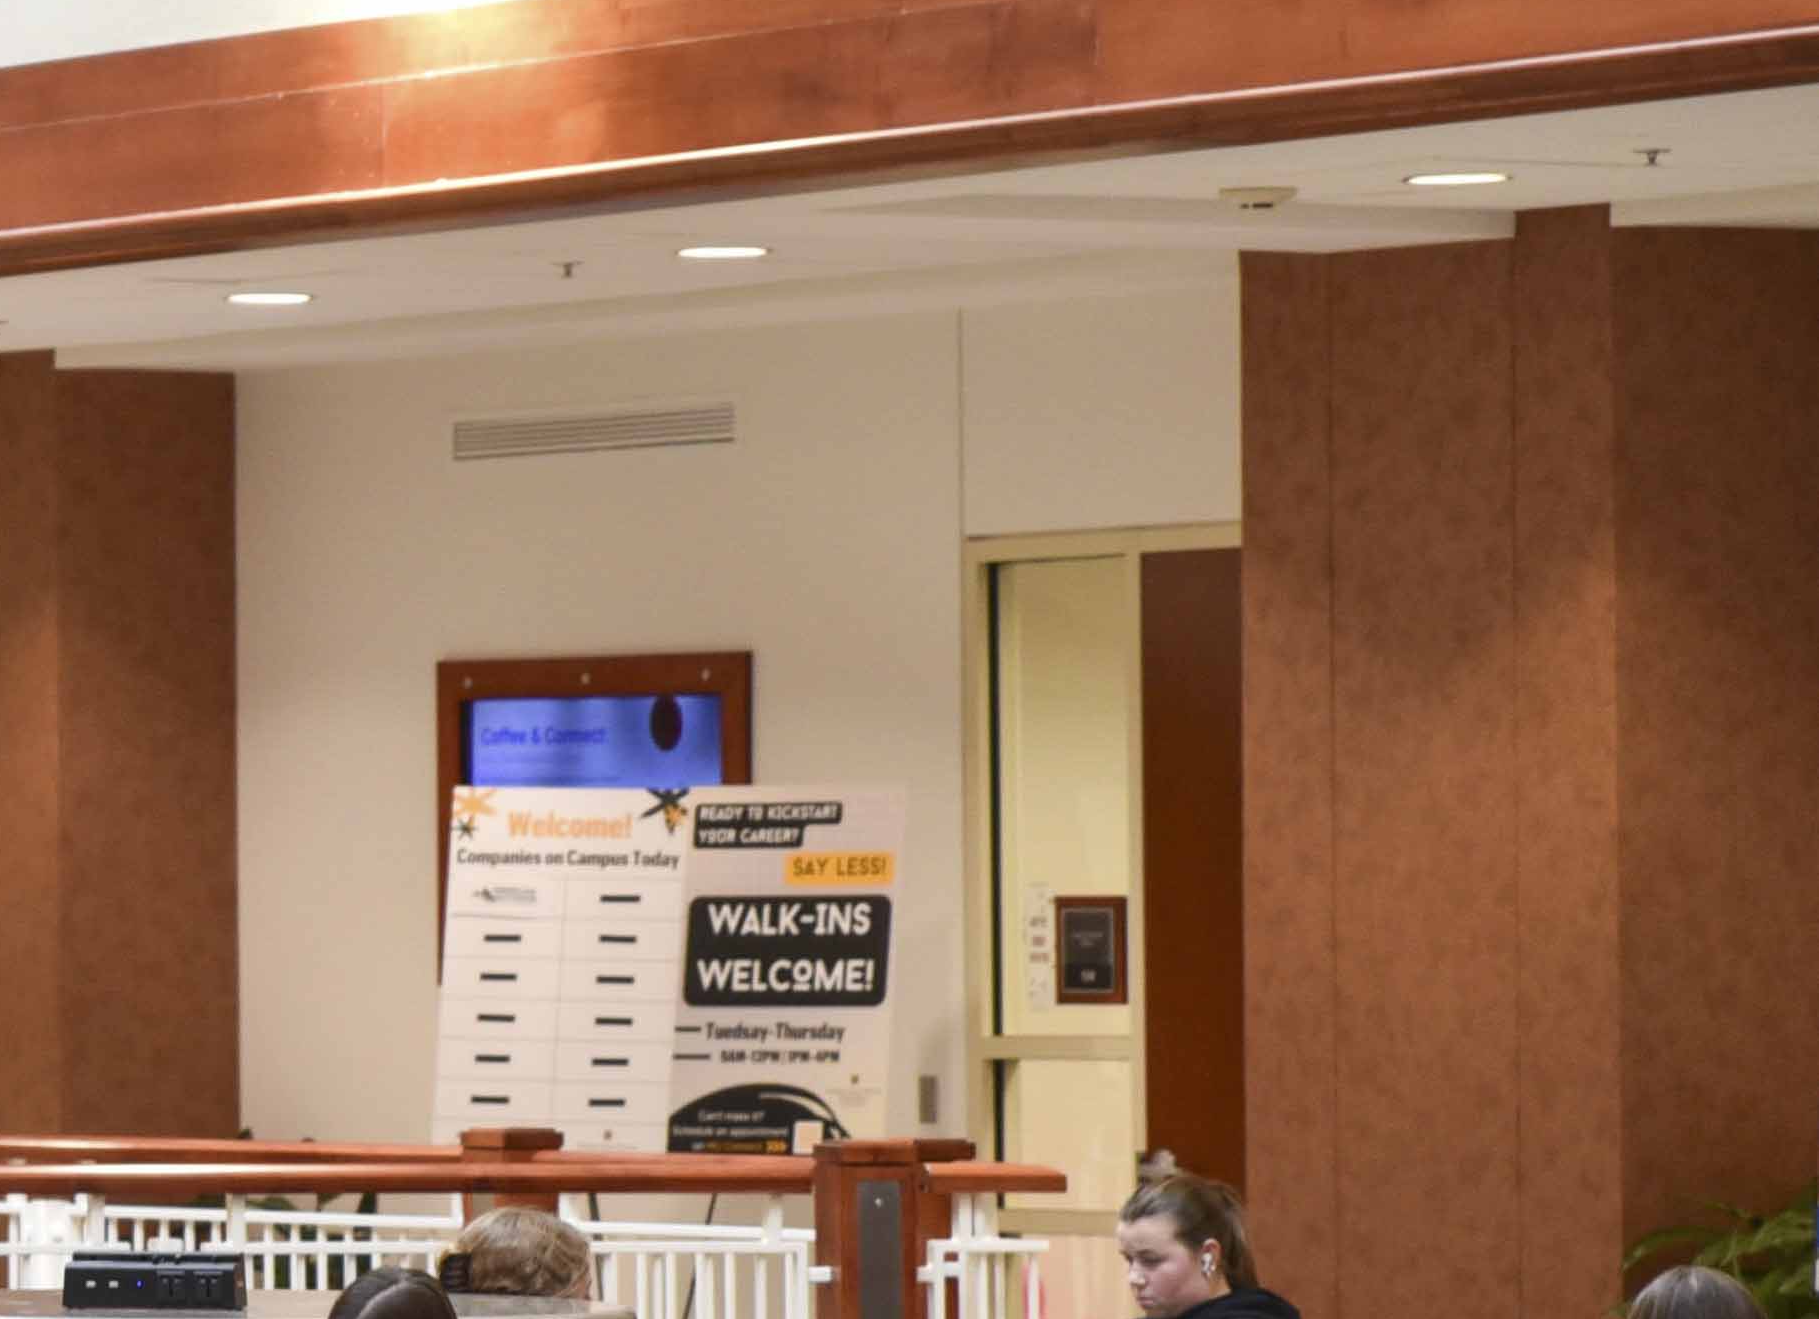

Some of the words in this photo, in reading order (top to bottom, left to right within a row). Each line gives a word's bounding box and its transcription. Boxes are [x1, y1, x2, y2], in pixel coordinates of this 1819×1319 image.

[481, 728, 527, 745] Coffee
[699, 805, 742, 821] READY
[748, 805, 763, 821] TO
[767, 803, 838, 820] KICKSTART
[508, 810, 633, 839] Welcome!
[698, 828, 735, 844] YOUR
[740, 827, 800, 843] CAREER?
[456, 848, 541, 868] Companies
[545, 853, 562, 866] on
[567, 850, 629, 868] Campus
[633, 850, 680, 870] Today
[792, 858, 829, 877] SAY
[836, 856, 887, 876] LESS!
[708, 901, 873, 936] WALK-INS
[696, 958, 875, 993] WELCOME!
